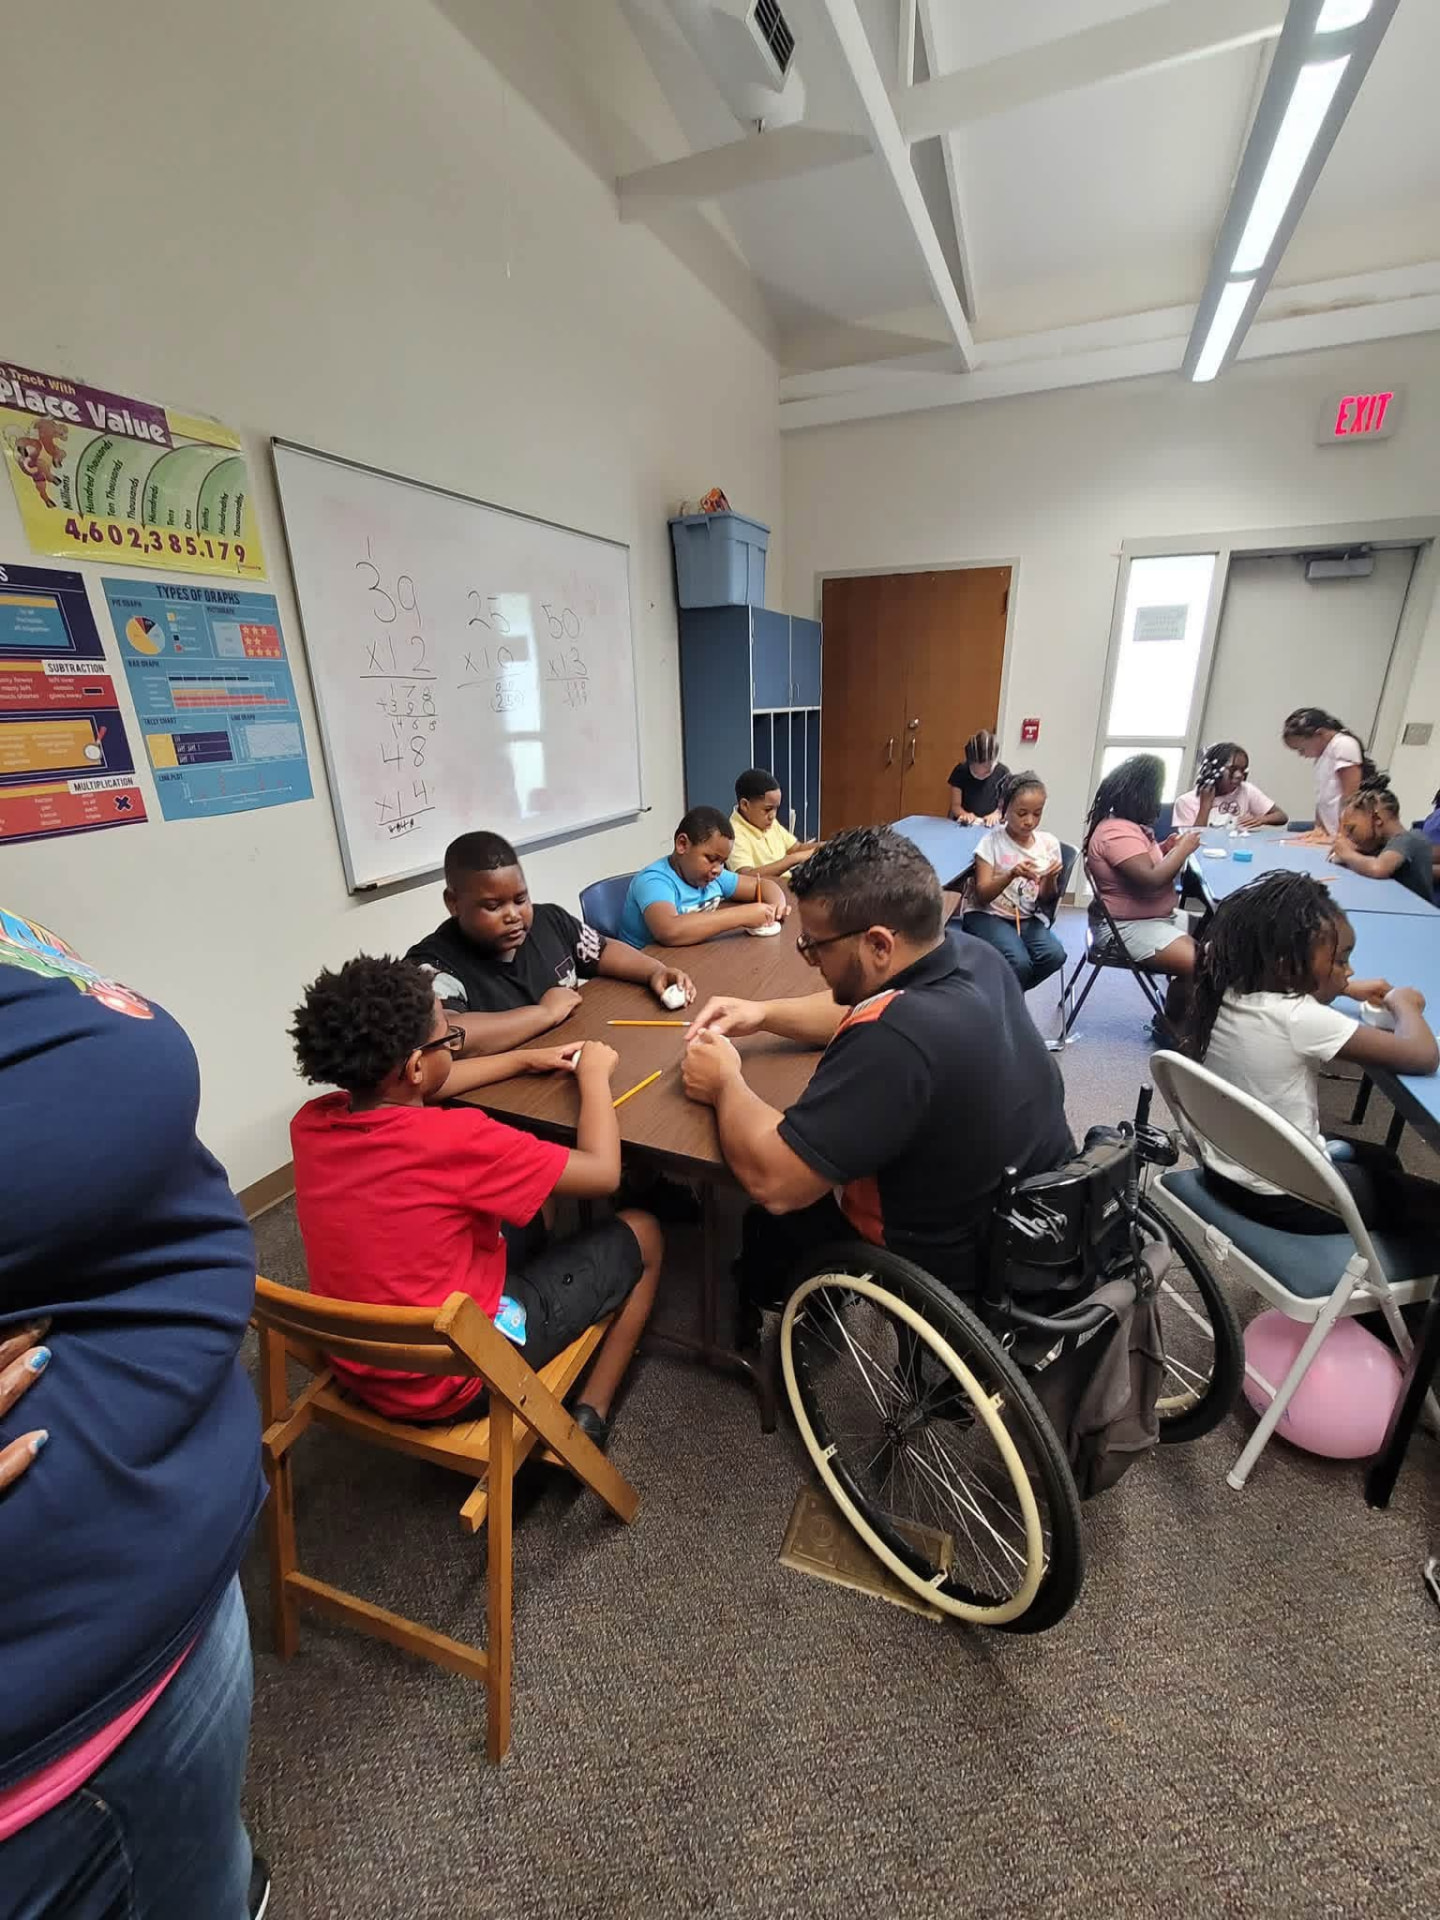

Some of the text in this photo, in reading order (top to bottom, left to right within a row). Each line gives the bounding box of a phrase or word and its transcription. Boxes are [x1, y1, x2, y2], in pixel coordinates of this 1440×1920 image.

[8, 367, 46, 388] Track
[48, 378, 77, 396] With
[0, 376, 167, 443] Place Value
[1335, 392, 1393, 436] EXIT
[61, 474, 73, 511] Millions
[83, 439, 114, 515] Hundred Thousands
[105, 459, 124, 517] Ten Thousands
[126, 475, 140, 521] Thousands
[148, 484, 160, 524] Hundreds
[166, 509, 176, 526] Tens
[184, 508, 193, 530] Ones
[156, 585, 241, 606] TYPES OF GRAPHS
[355, 561, 422, 628] 39
[540, 604, 580, 640] 50
[47, 662, 105, 674] SUBTRACTION
[380, 736, 427, 771] 48
[73, 777, 135, 792] MULTIPLICATION
